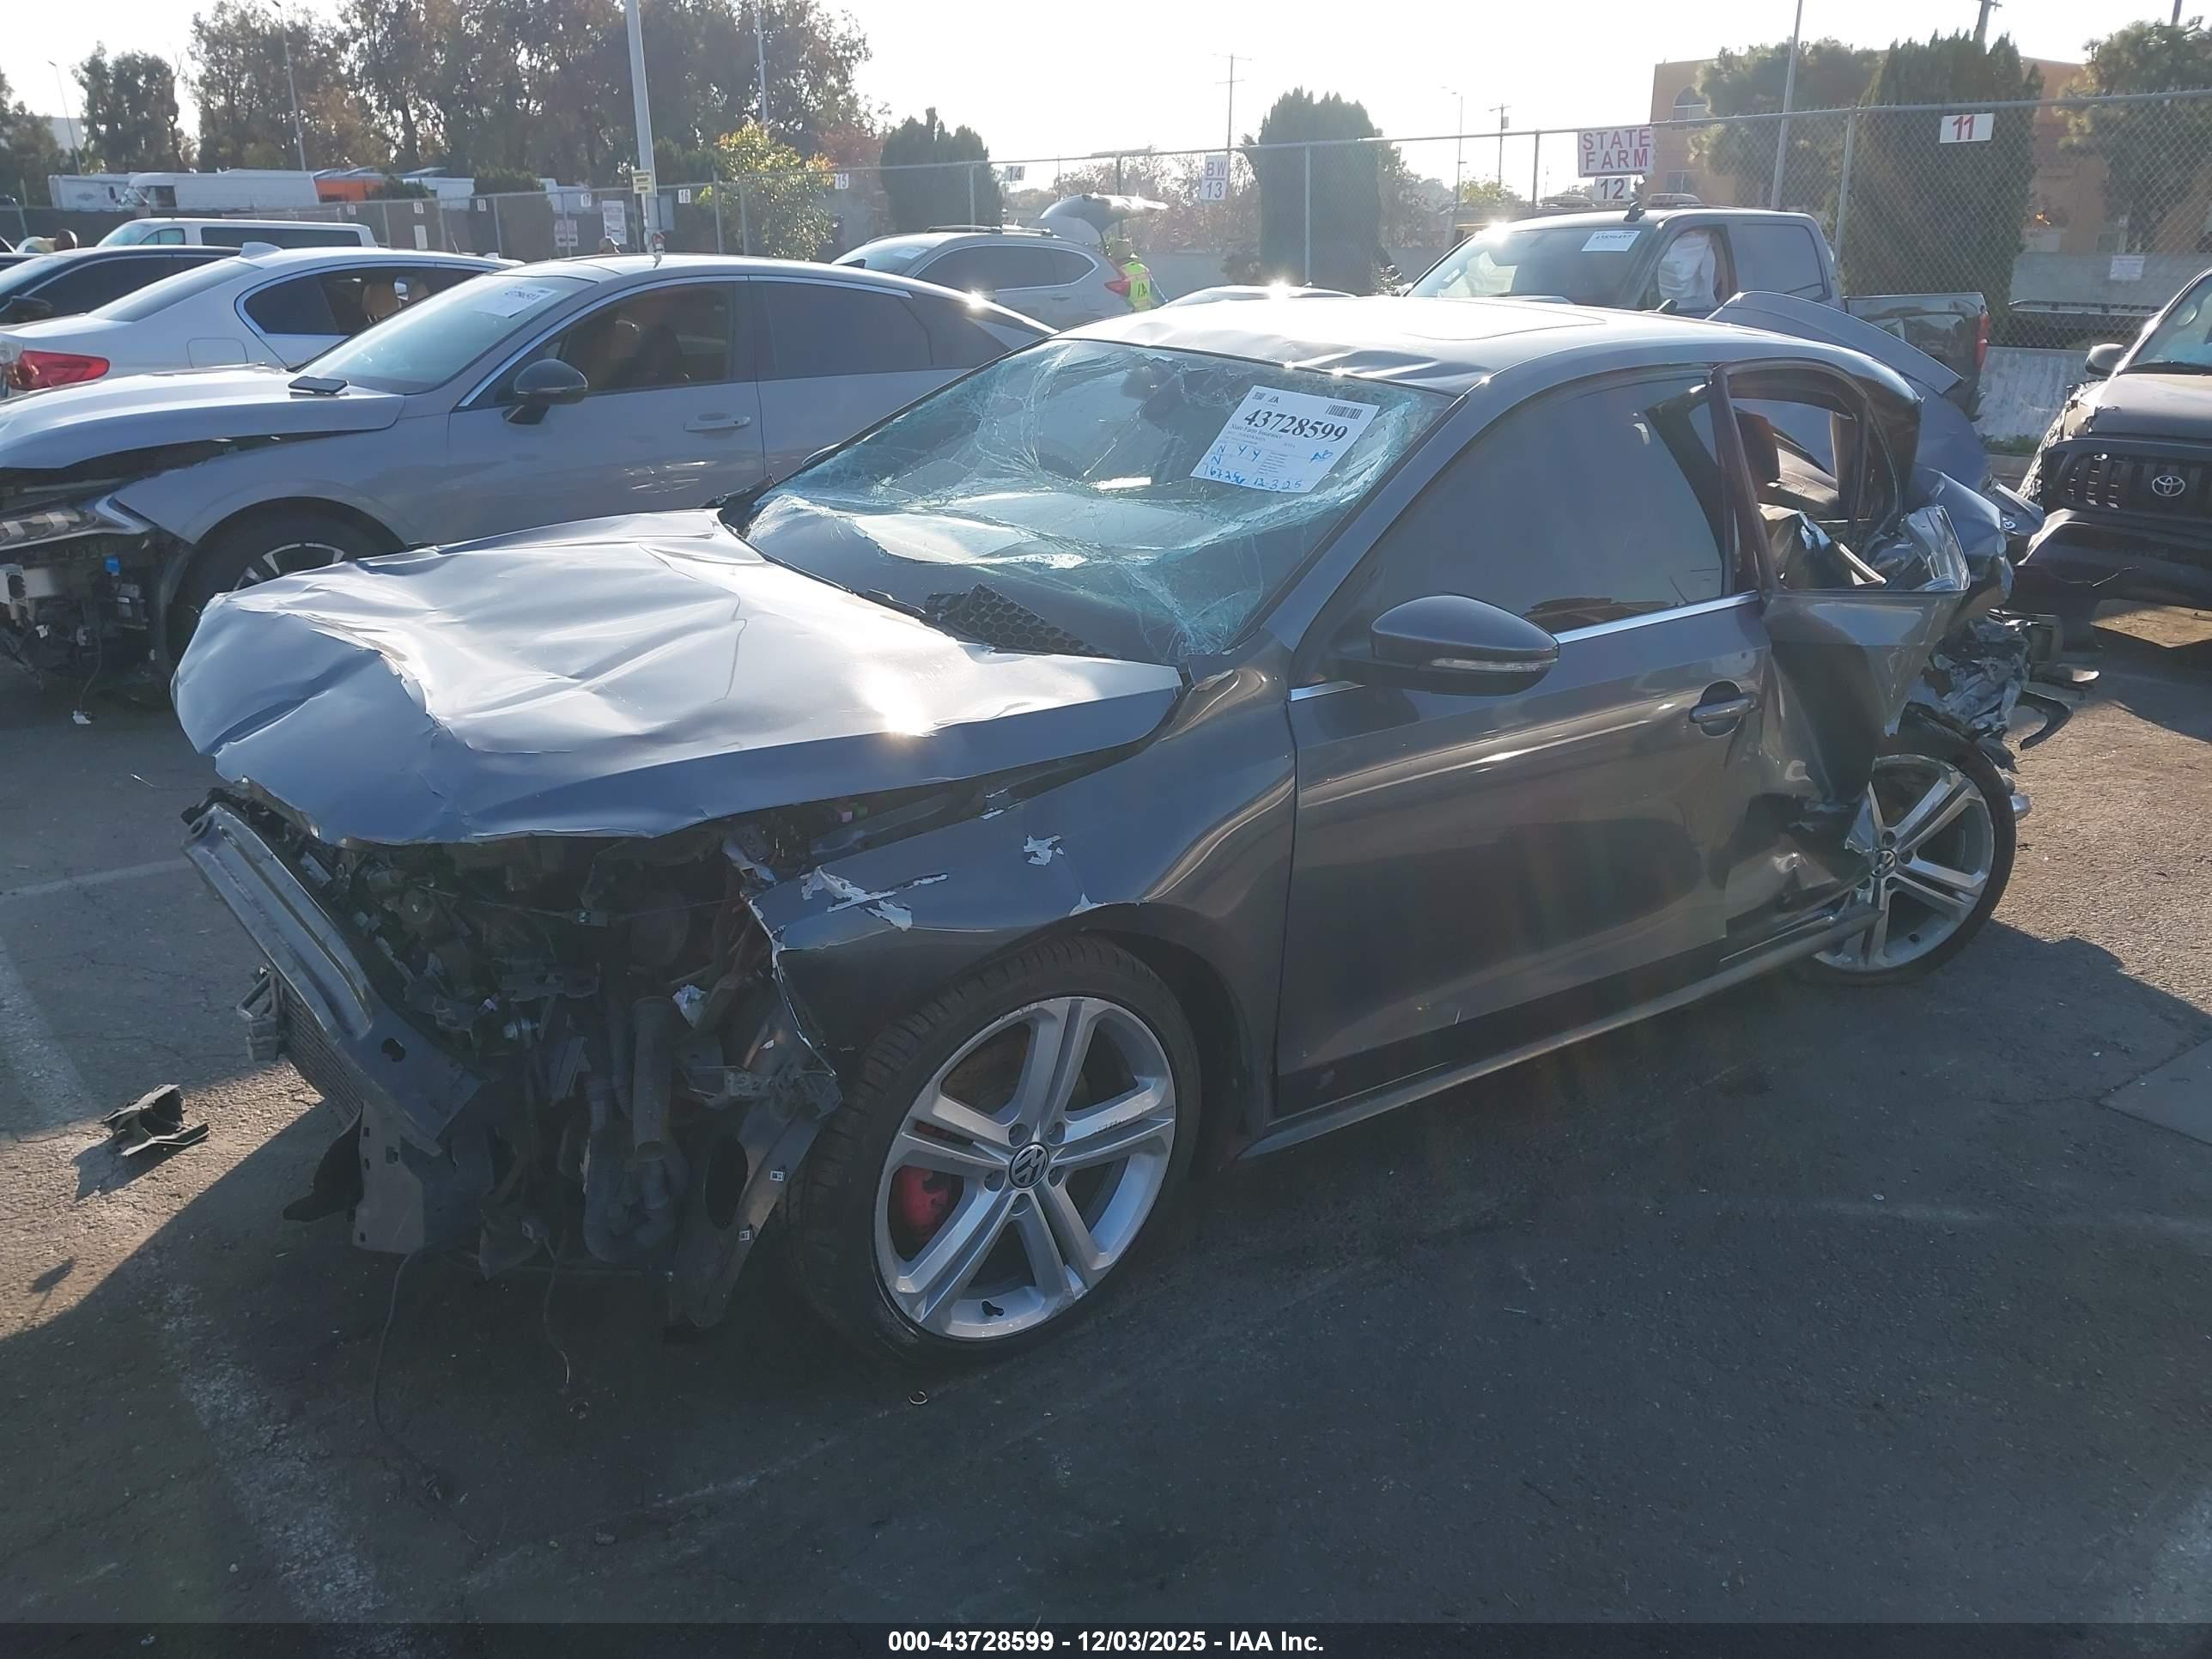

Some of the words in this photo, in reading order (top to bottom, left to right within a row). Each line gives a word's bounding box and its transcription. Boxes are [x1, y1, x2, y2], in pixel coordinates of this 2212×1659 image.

[1953, 114, 1975, 140] 11
[1583, 129, 1651, 150] STATE
[1206, 161, 1226, 177] BW
[1585, 148, 1648, 170] FARM
[837, 173, 848, 188] 15
[1206, 181, 1223, 198] 13
[1600, 178, 1625, 200] 12
[1244, 409, 1348, 442] 43728599
